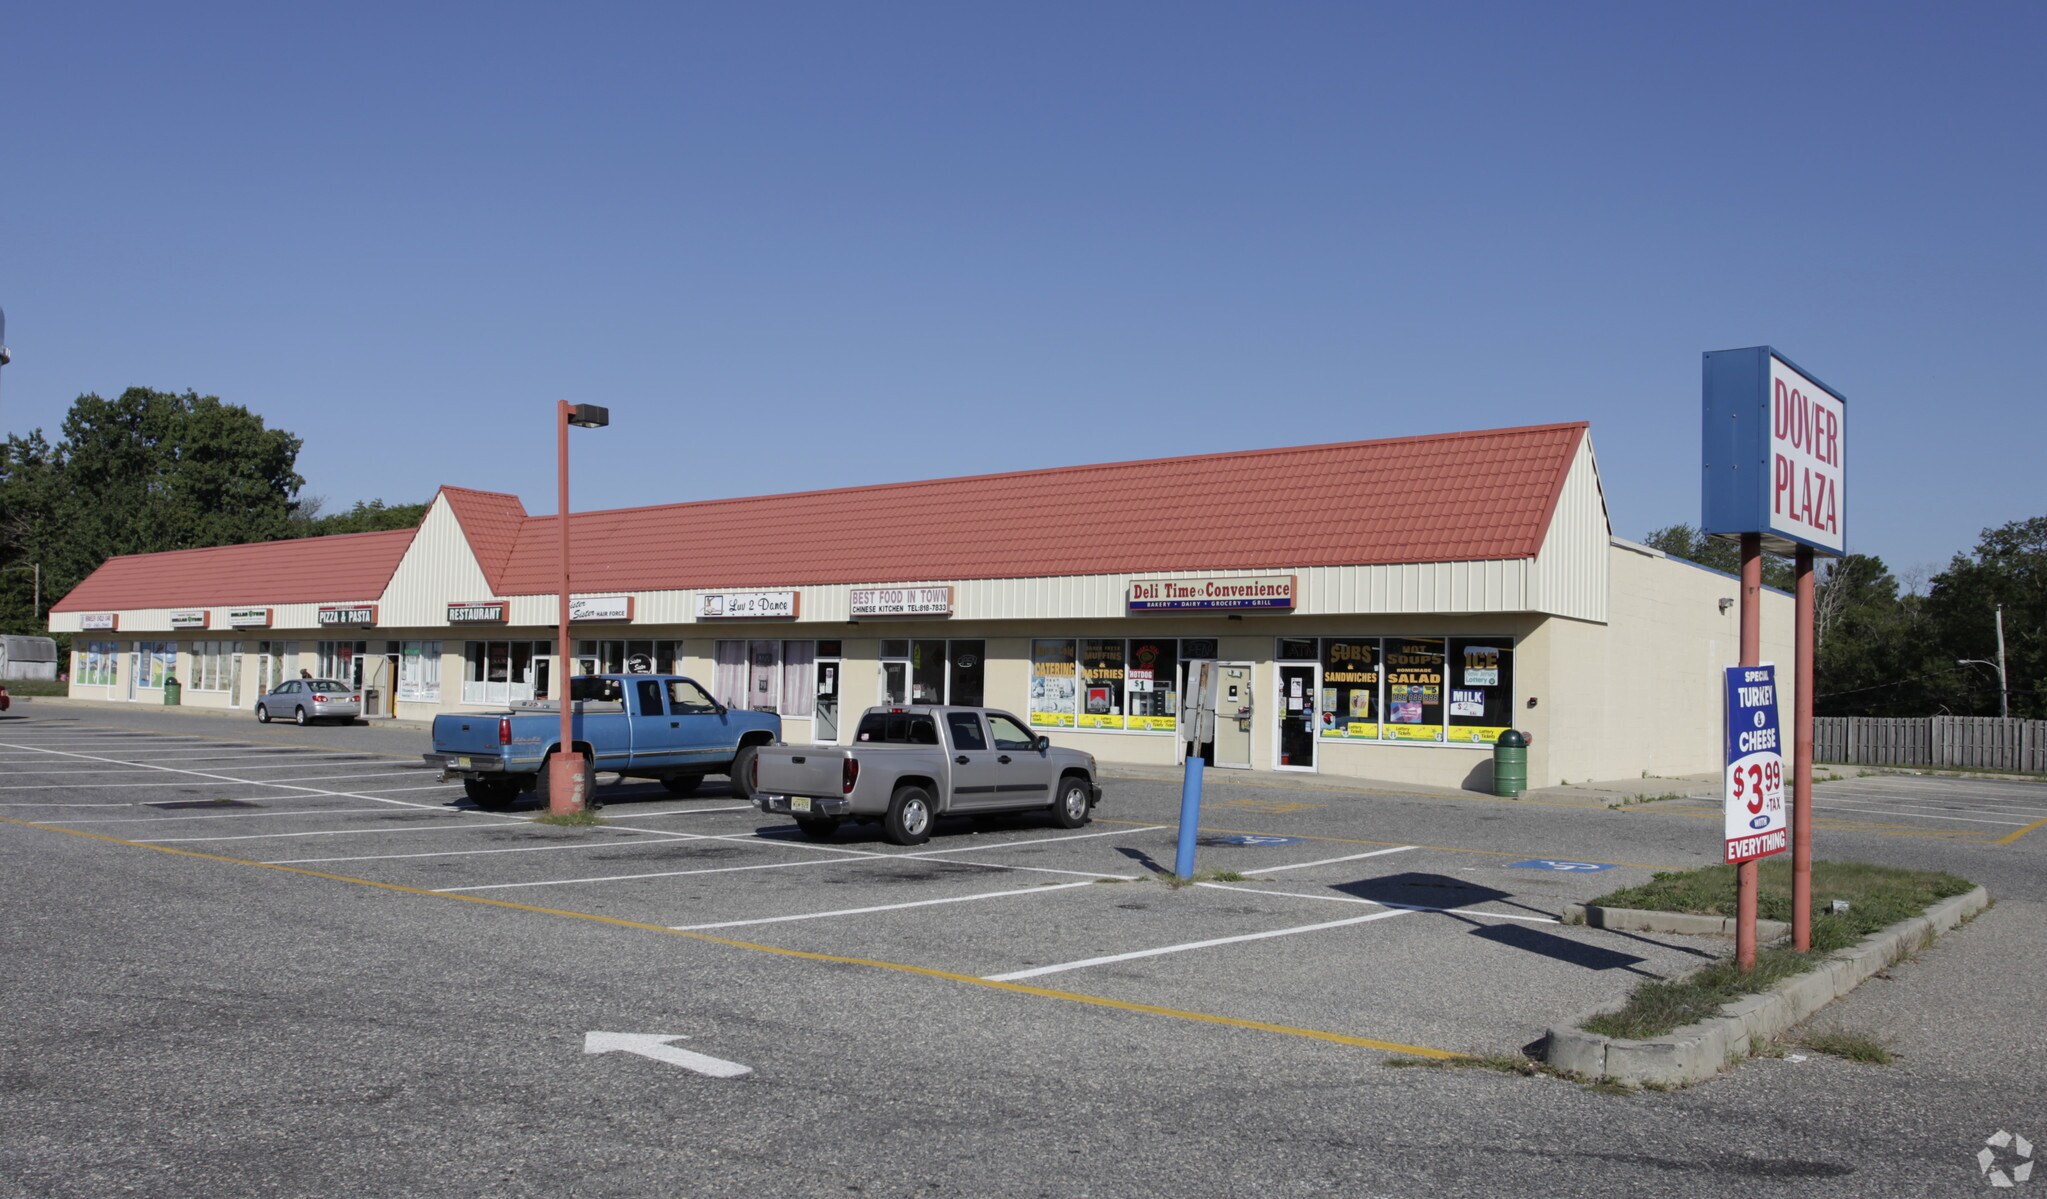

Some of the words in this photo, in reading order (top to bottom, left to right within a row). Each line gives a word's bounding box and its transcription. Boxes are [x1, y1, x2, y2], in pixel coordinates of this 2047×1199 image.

[1775, 377, 1838, 468] DOVER
[1776, 453, 1836, 534] PLAZA
[853, 592, 875, 604] BEST
[880, 591, 902, 603] FOOD
[908, 590, 915, 603] IN
[921, 590, 946, 602] TOWN
[1134, 584, 1158, 599] Deli
[1165, 583, 1196, 597] Time
[1206, 581, 1289, 597] Convenience
[729, 599, 746, 612] Luv
[749, 600, 754, 610] 2
[758, 598, 787, 610] Dance
[320, 611, 338, 623] PIZZA
[341, 611, 346, 622] &
[350, 610, 370, 622] PASTA
[450, 608, 500, 621] RESTAURANT
[573, 610, 594, 619] Sister
[1085, 652, 1121, 660] MUFFINS
[1331, 645, 1371, 663] SUBS
[1387, 654, 1441, 664] SOUPS
[1465, 652, 1498, 669] ICE
[1035, 663, 1075, 677] CATERING
[1081, 669, 1123, 679] PASTRIES
[1325, 672, 1377, 683] SANDWICHES
[1388, 674, 1440, 684] SALAD
[1453, 691, 1482, 702] MILK
[1738, 686, 1772, 708] TURKEY
[1758, 713, 1762, 725] &
[1739, 728, 1776, 752] CHEESE
[1728, 831, 1785, 859] EVERYTHING
